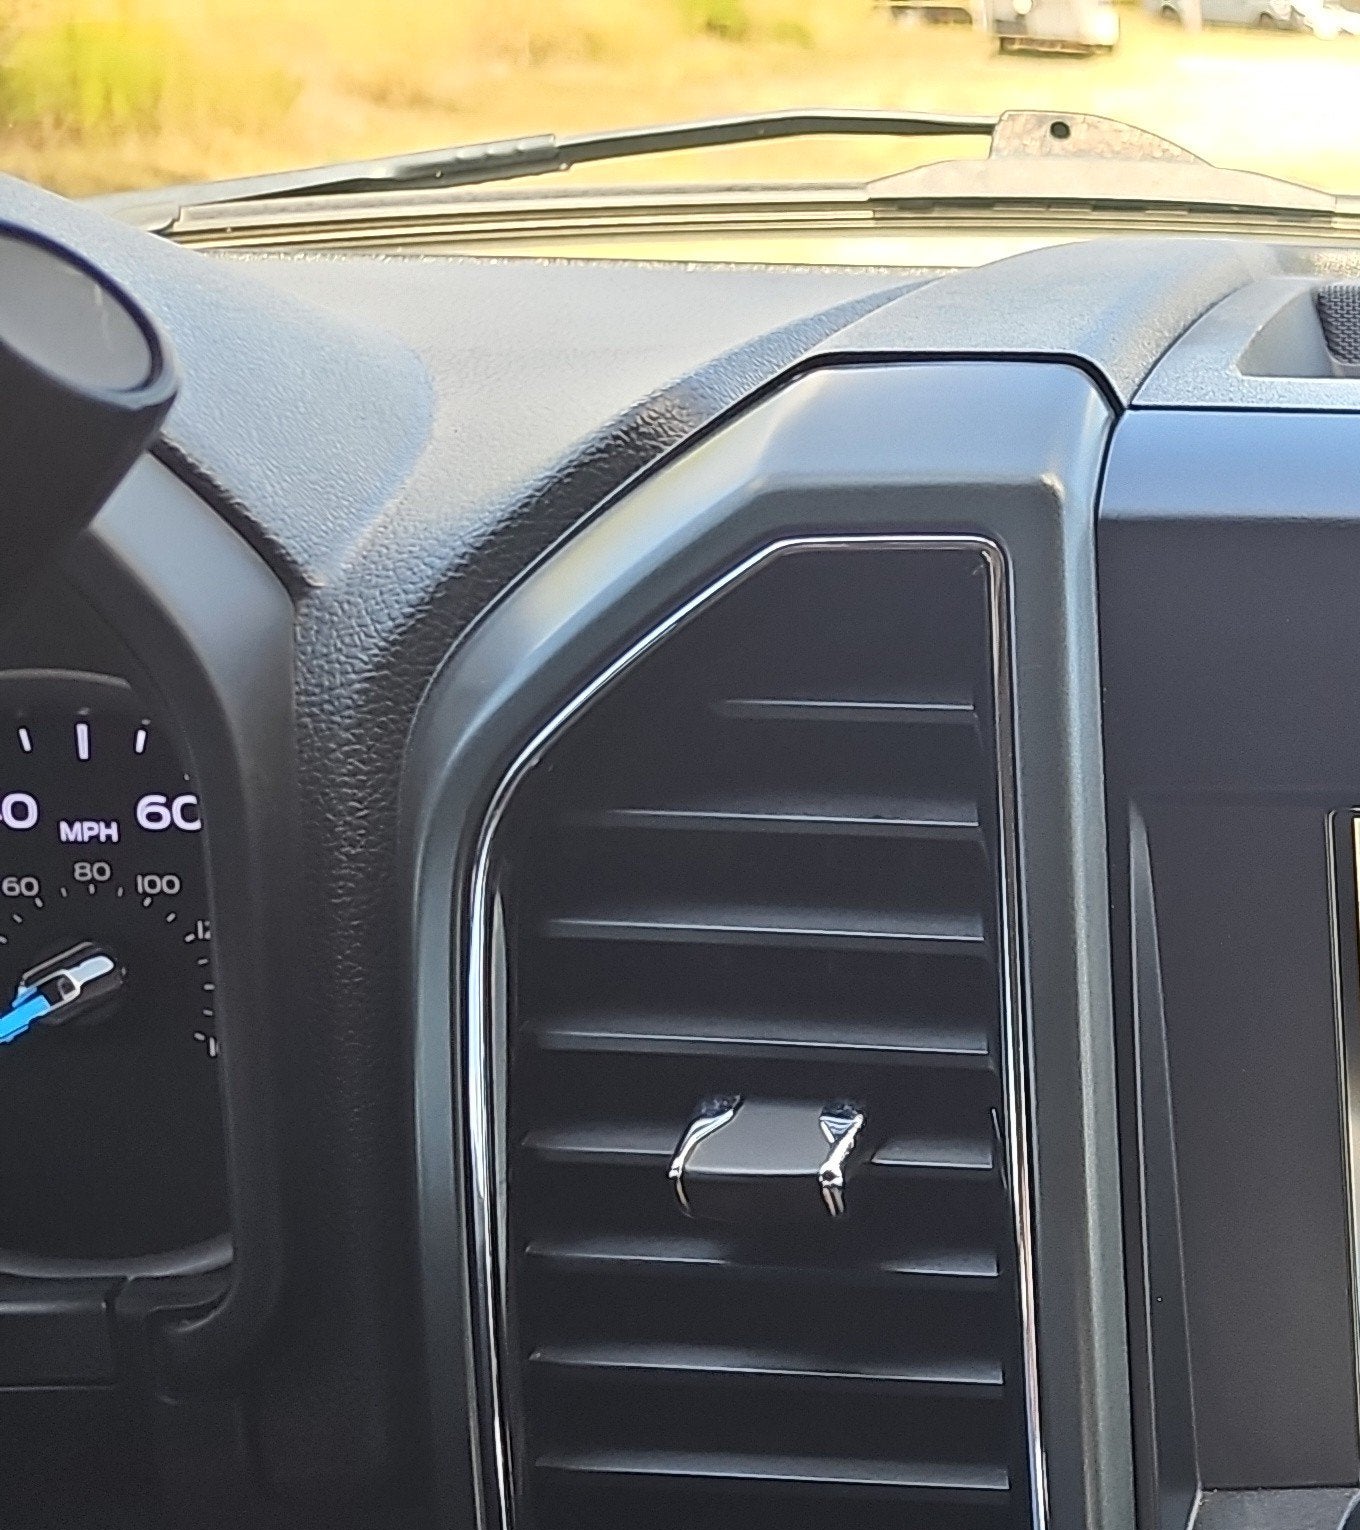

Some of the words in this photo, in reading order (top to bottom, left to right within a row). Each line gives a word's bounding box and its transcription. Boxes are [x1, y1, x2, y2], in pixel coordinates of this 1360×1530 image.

[0, 794, 38, 829] 0
[60, 821, 118, 842] MPH
[74, 862, 110, 881] 80
[2, 877, 40, 897] 60
[137, 875, 181, 895] 100
